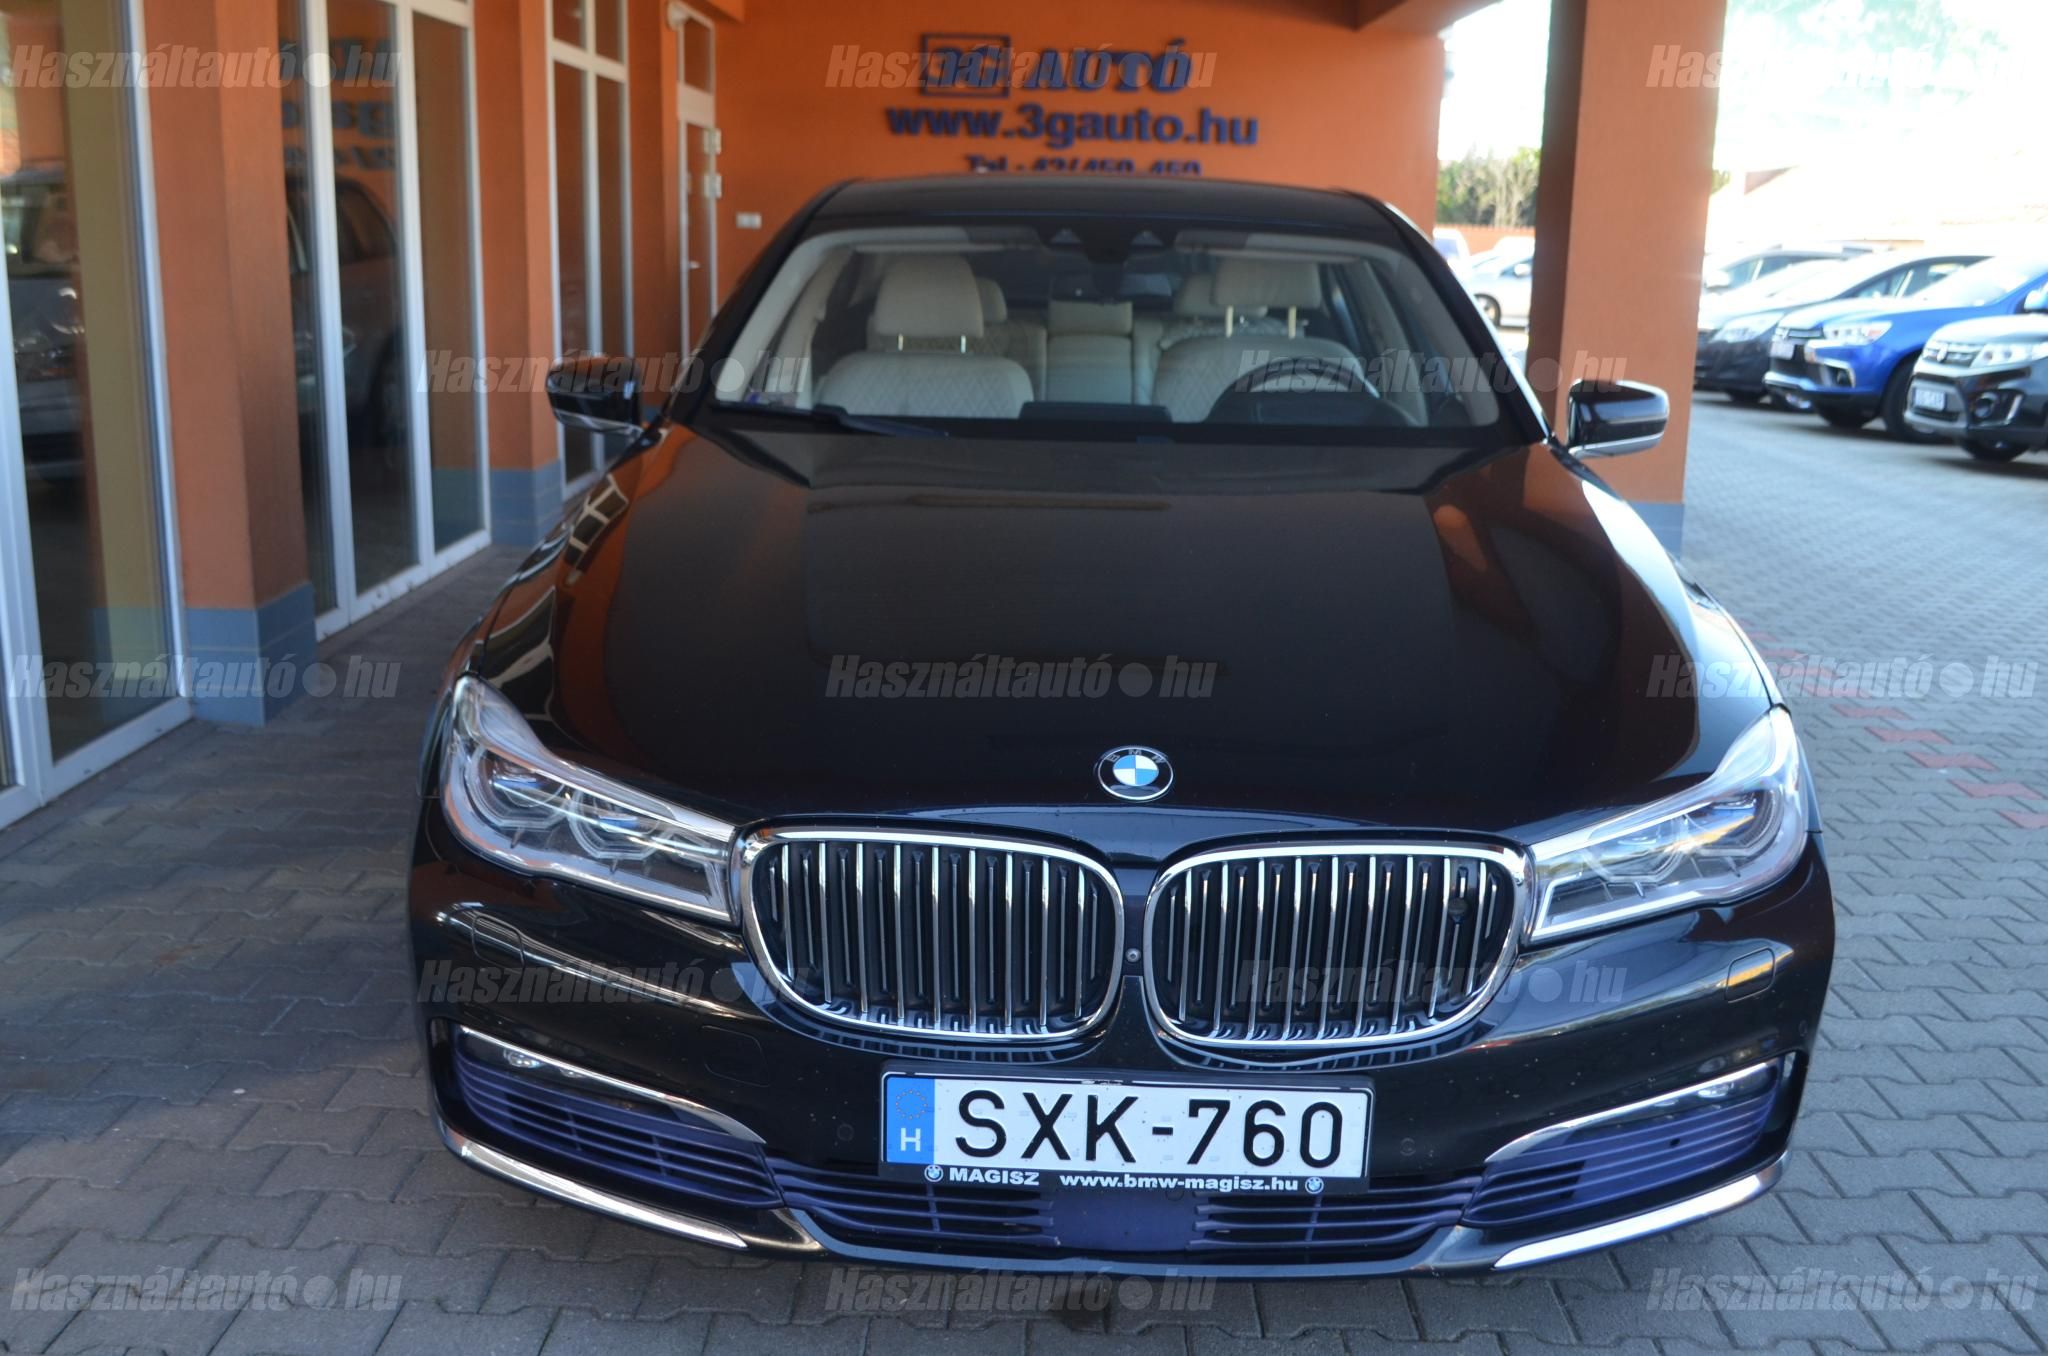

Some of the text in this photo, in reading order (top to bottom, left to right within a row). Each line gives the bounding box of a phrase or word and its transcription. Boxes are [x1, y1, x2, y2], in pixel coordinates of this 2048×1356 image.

[1019, 38, 1194, 93] AUTÓ
[885, 102, 1259, 148] www.3gauto.hu
[900, 1089, 1343, 1168] H SXK-760
[949, 1168, 1299, 1193] MAGISZ www.bmw-magisz.hu
